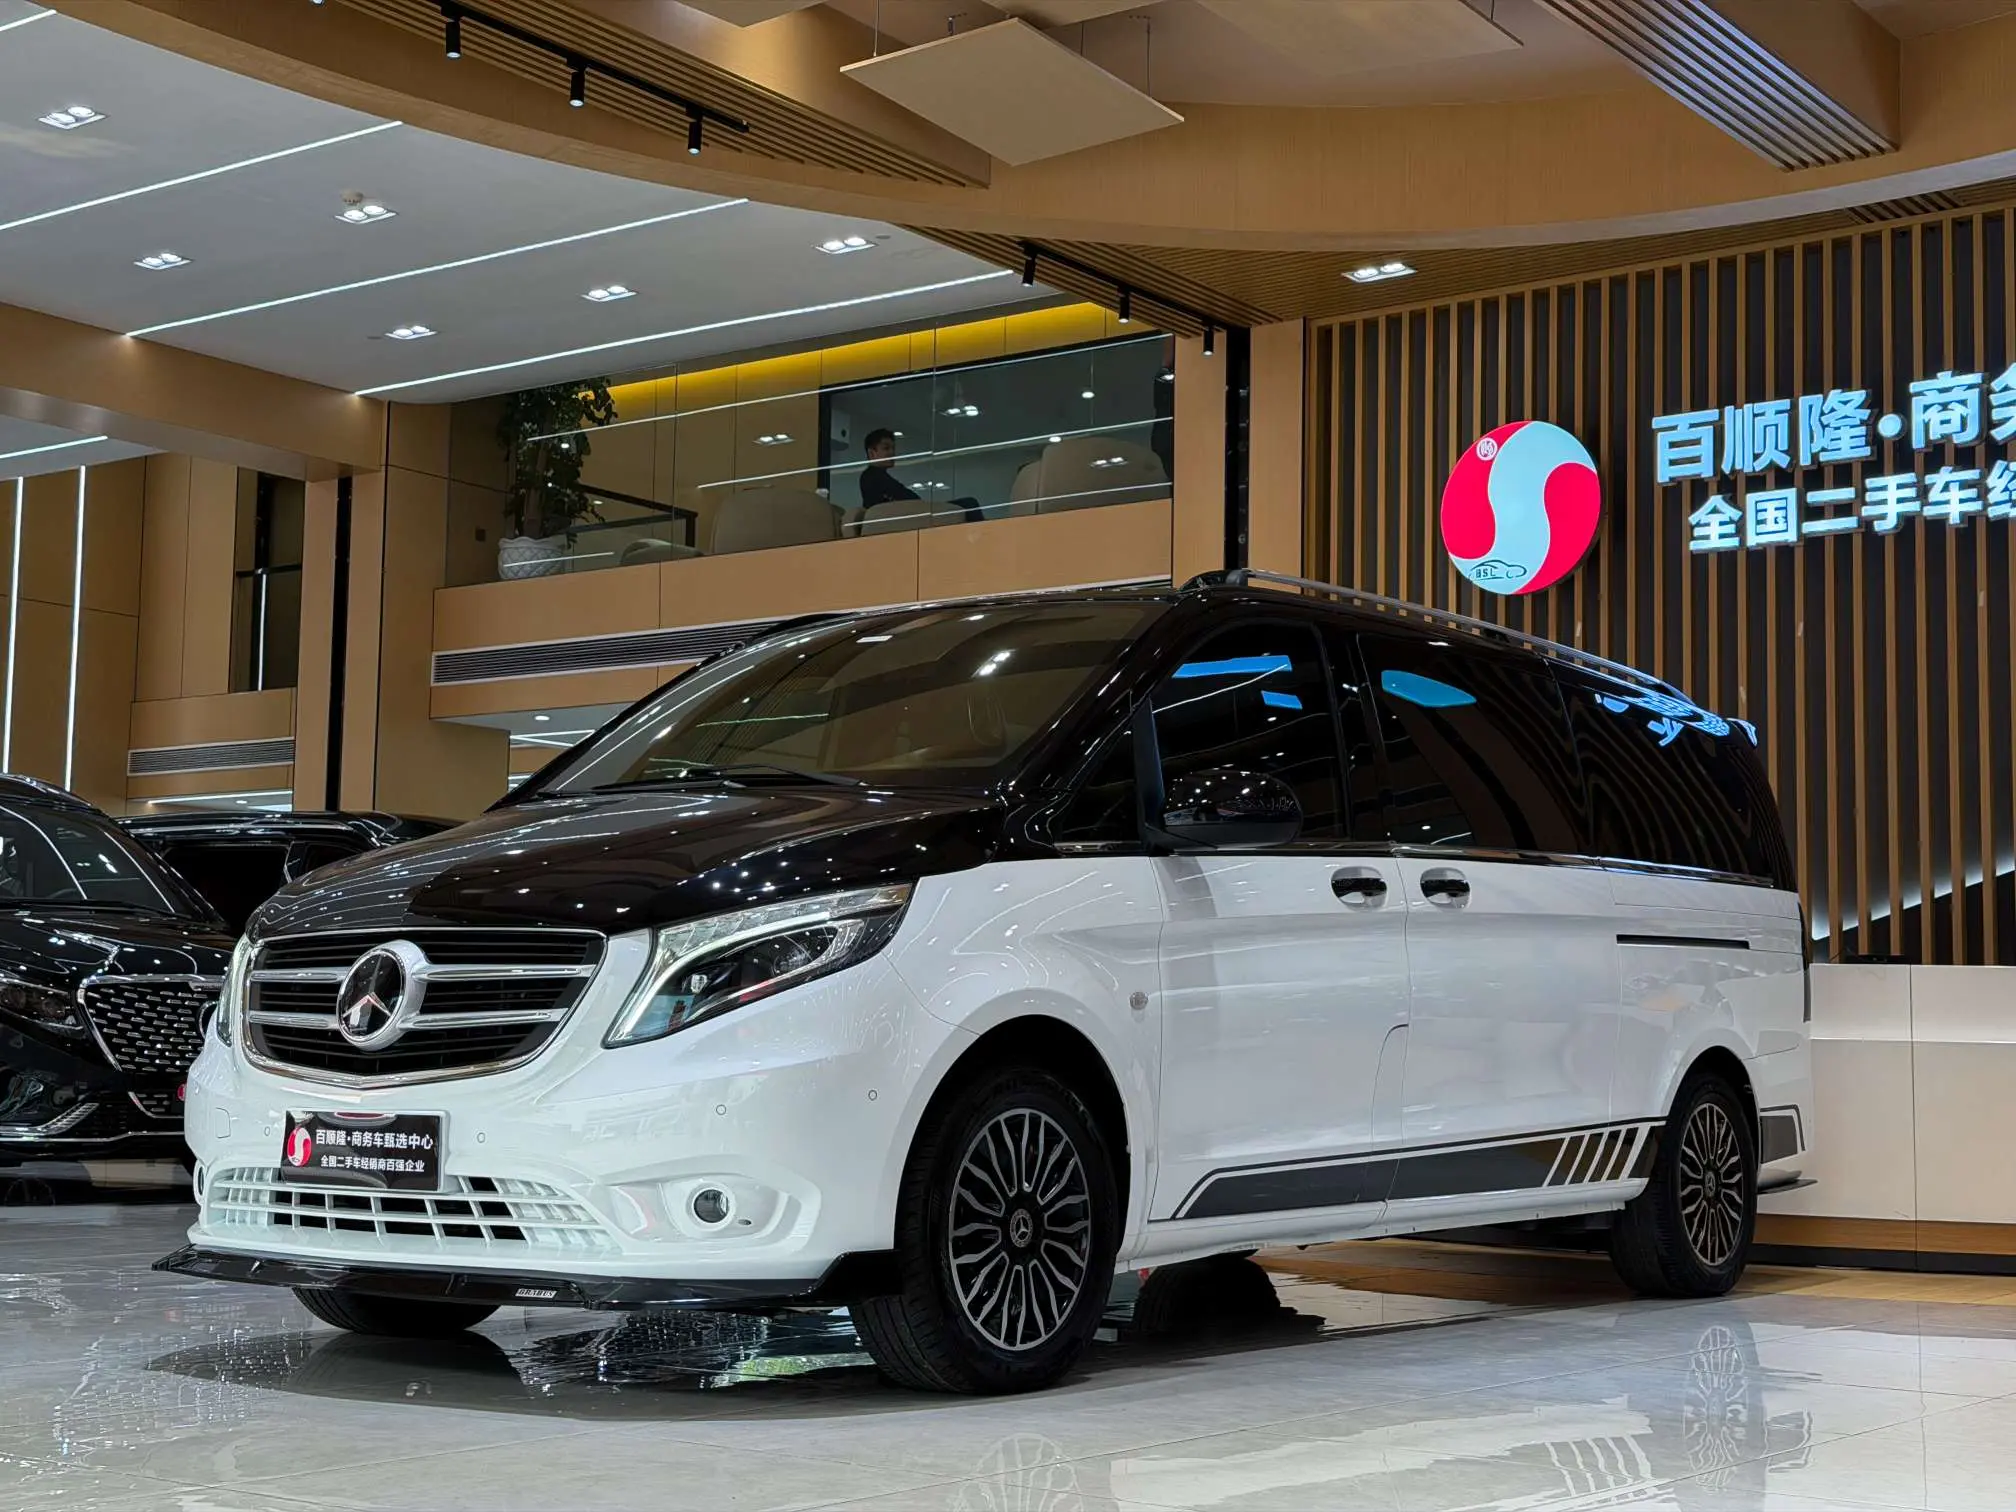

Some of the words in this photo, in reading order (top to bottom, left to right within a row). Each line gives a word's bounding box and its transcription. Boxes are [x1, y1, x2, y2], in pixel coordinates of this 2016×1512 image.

[1475, 568, 1496, 578] BSL
[315, 1129, 433, 1150] 百顺隆·商务车甄选中心
[320, 1154, 425, 1172] 全国二手车经销商百强企业
